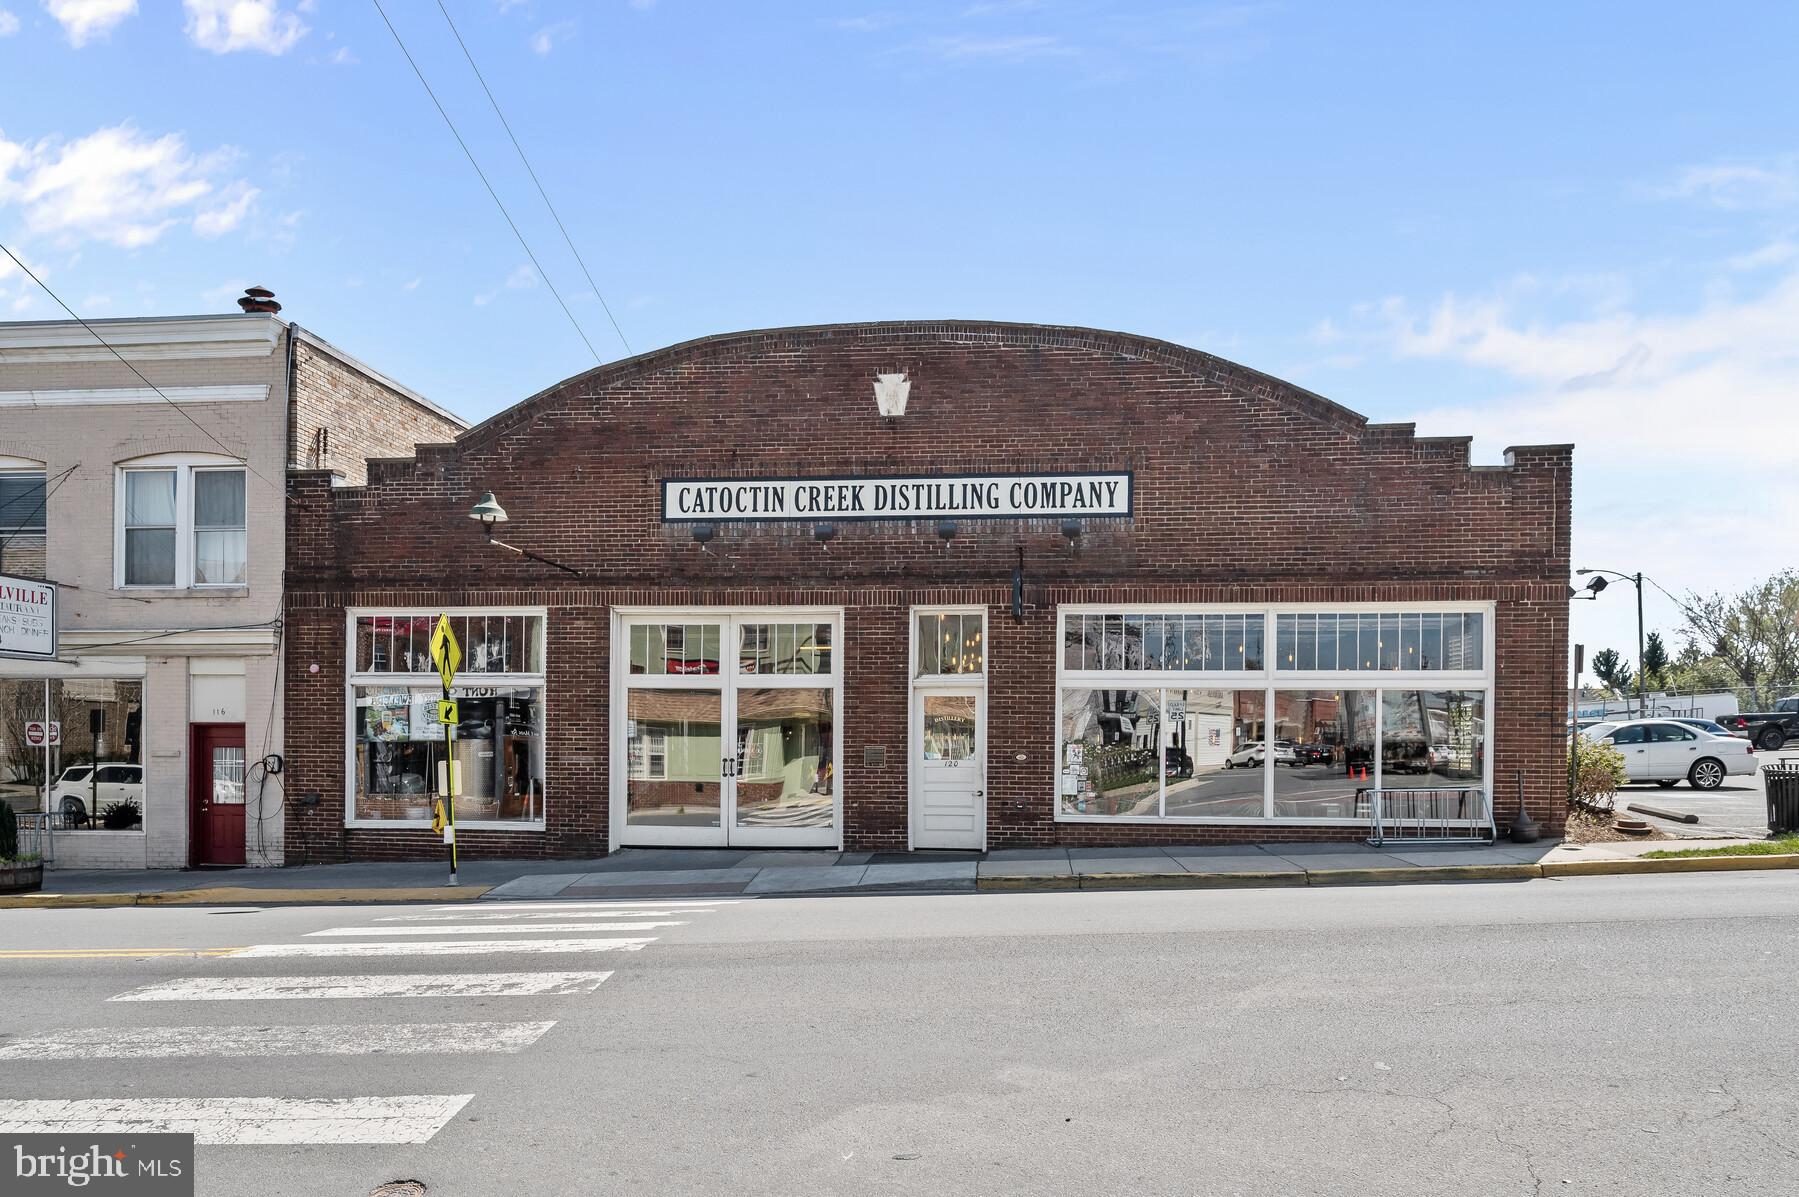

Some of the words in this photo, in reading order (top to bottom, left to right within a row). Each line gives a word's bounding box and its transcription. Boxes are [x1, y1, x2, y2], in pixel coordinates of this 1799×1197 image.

[678, 486, 785, 514] CATOCTIN
[794, 485, 865, 512] CREEK
[873, 482, 1000, 511] DISTILLING
[1009, 481, 1119, 509] COMPANY
[212, 707, 226, 716] 116
[944, 760, 959, 768] 120
